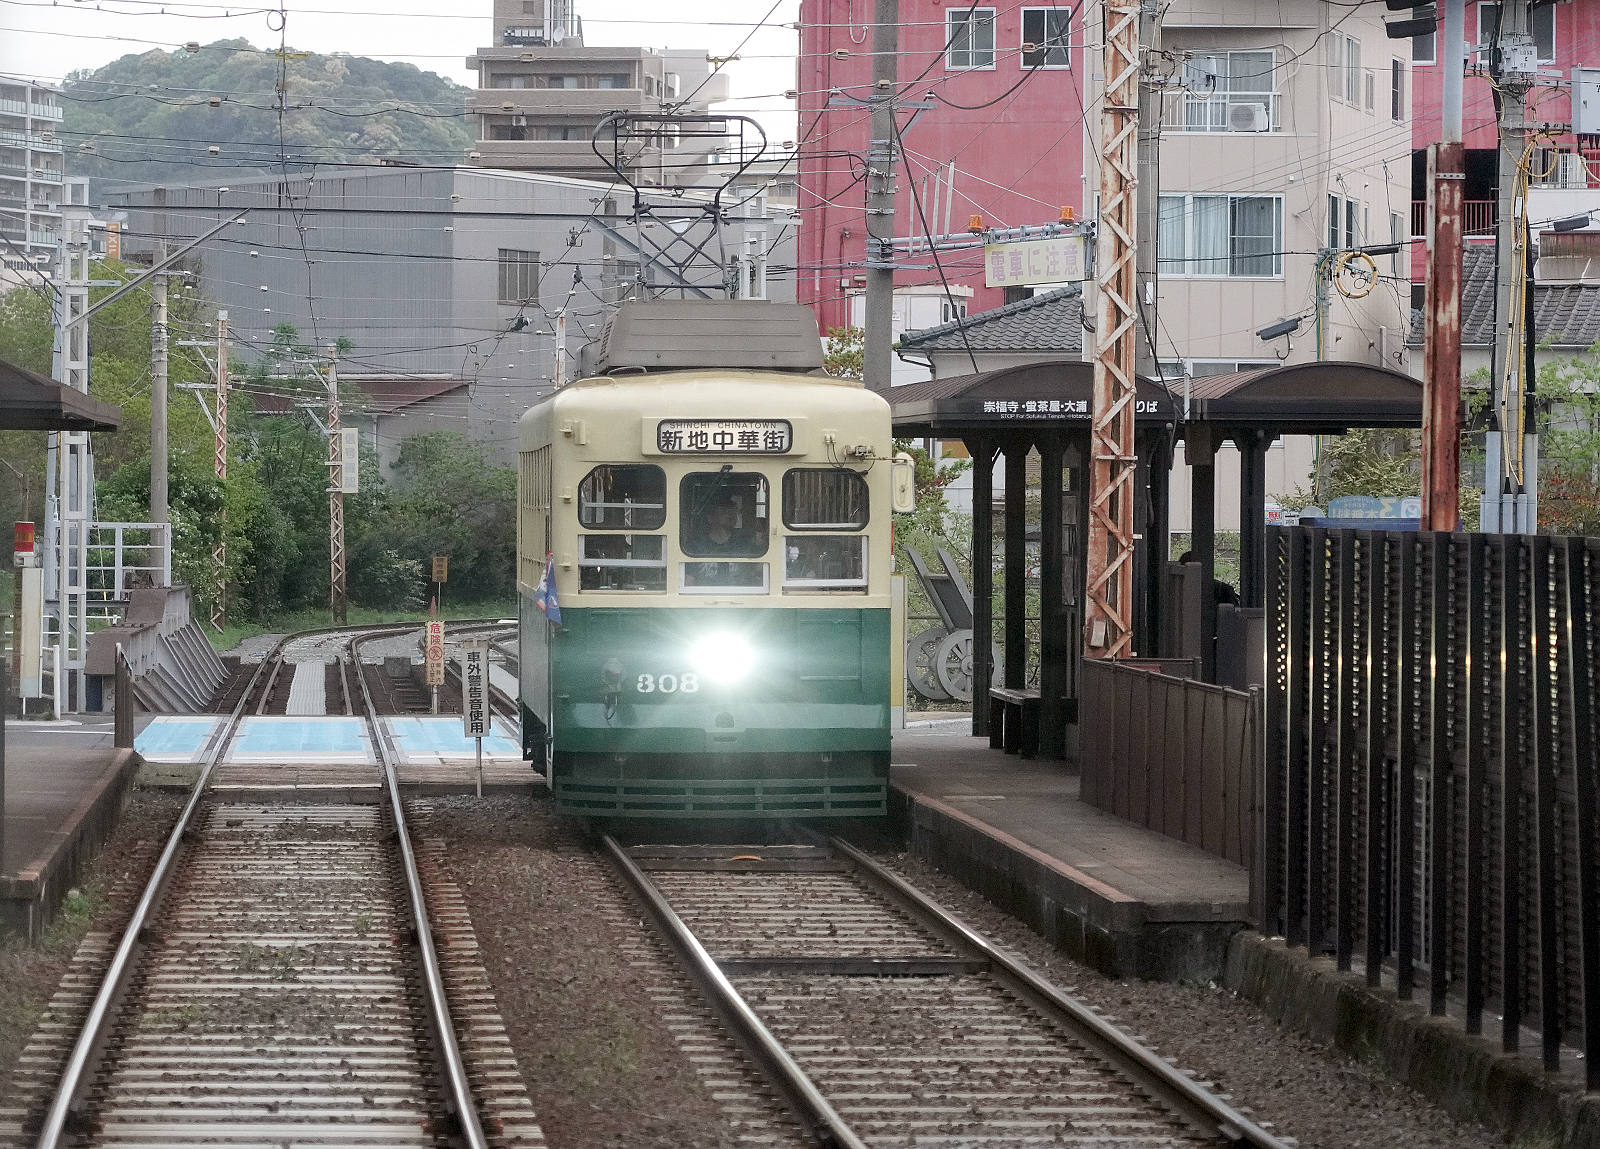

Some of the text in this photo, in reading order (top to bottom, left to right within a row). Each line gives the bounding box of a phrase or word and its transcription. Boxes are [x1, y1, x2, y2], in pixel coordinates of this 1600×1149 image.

[109, 225, 118, 254] LIXIL
[990, 243, 1079, 282] 電車に注意
[661, 430, 785, 451] 新地中華街
[430, 623, 441, 646] 危険
[467, 651, 484, 734] 車外警告音使用
[636, 673, 700, 693] 308
